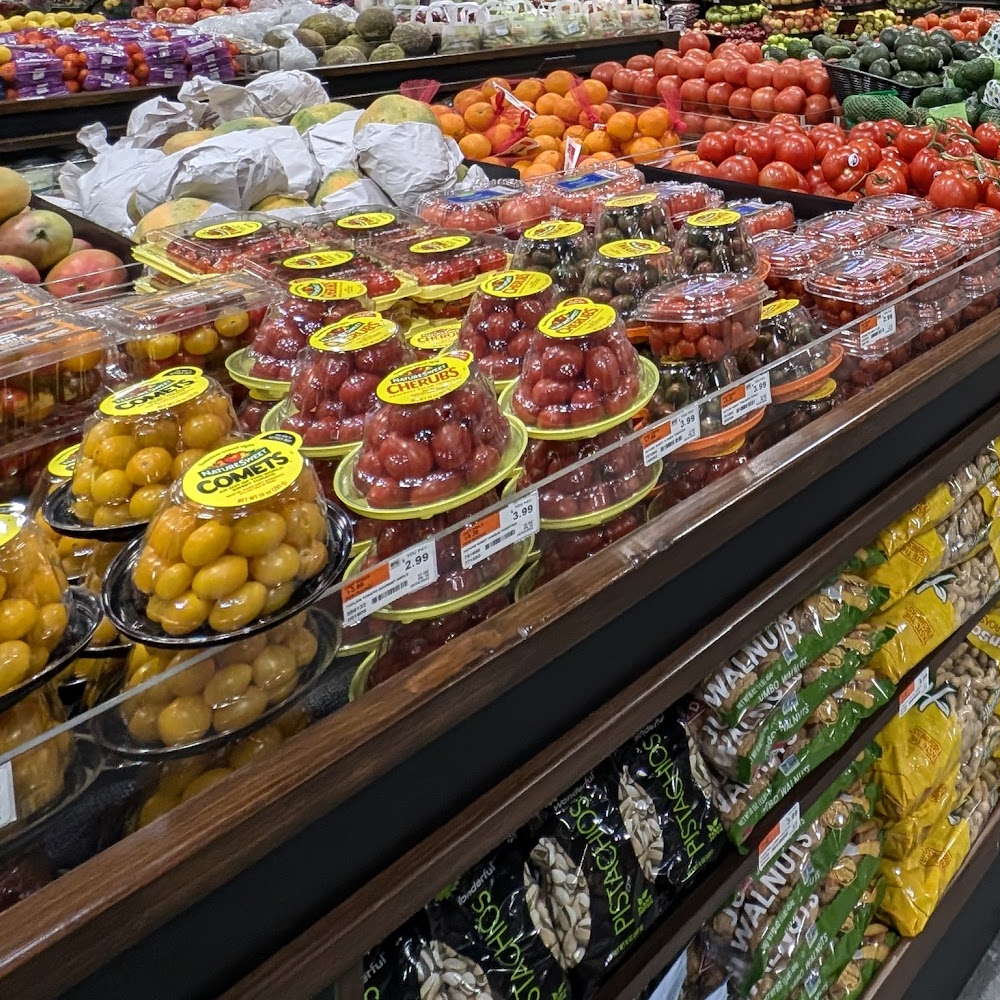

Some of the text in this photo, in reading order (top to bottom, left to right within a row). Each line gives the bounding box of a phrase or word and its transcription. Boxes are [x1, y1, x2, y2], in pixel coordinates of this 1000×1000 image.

[114, 379, 195, 411] COMETS
[386, 366, 459, 395] CHERUBS
[196, 451, 289, 495] COMETS
[757, 680, 780, 703] UMBO
[569, 796, 635, 936] PISTACHIOS
